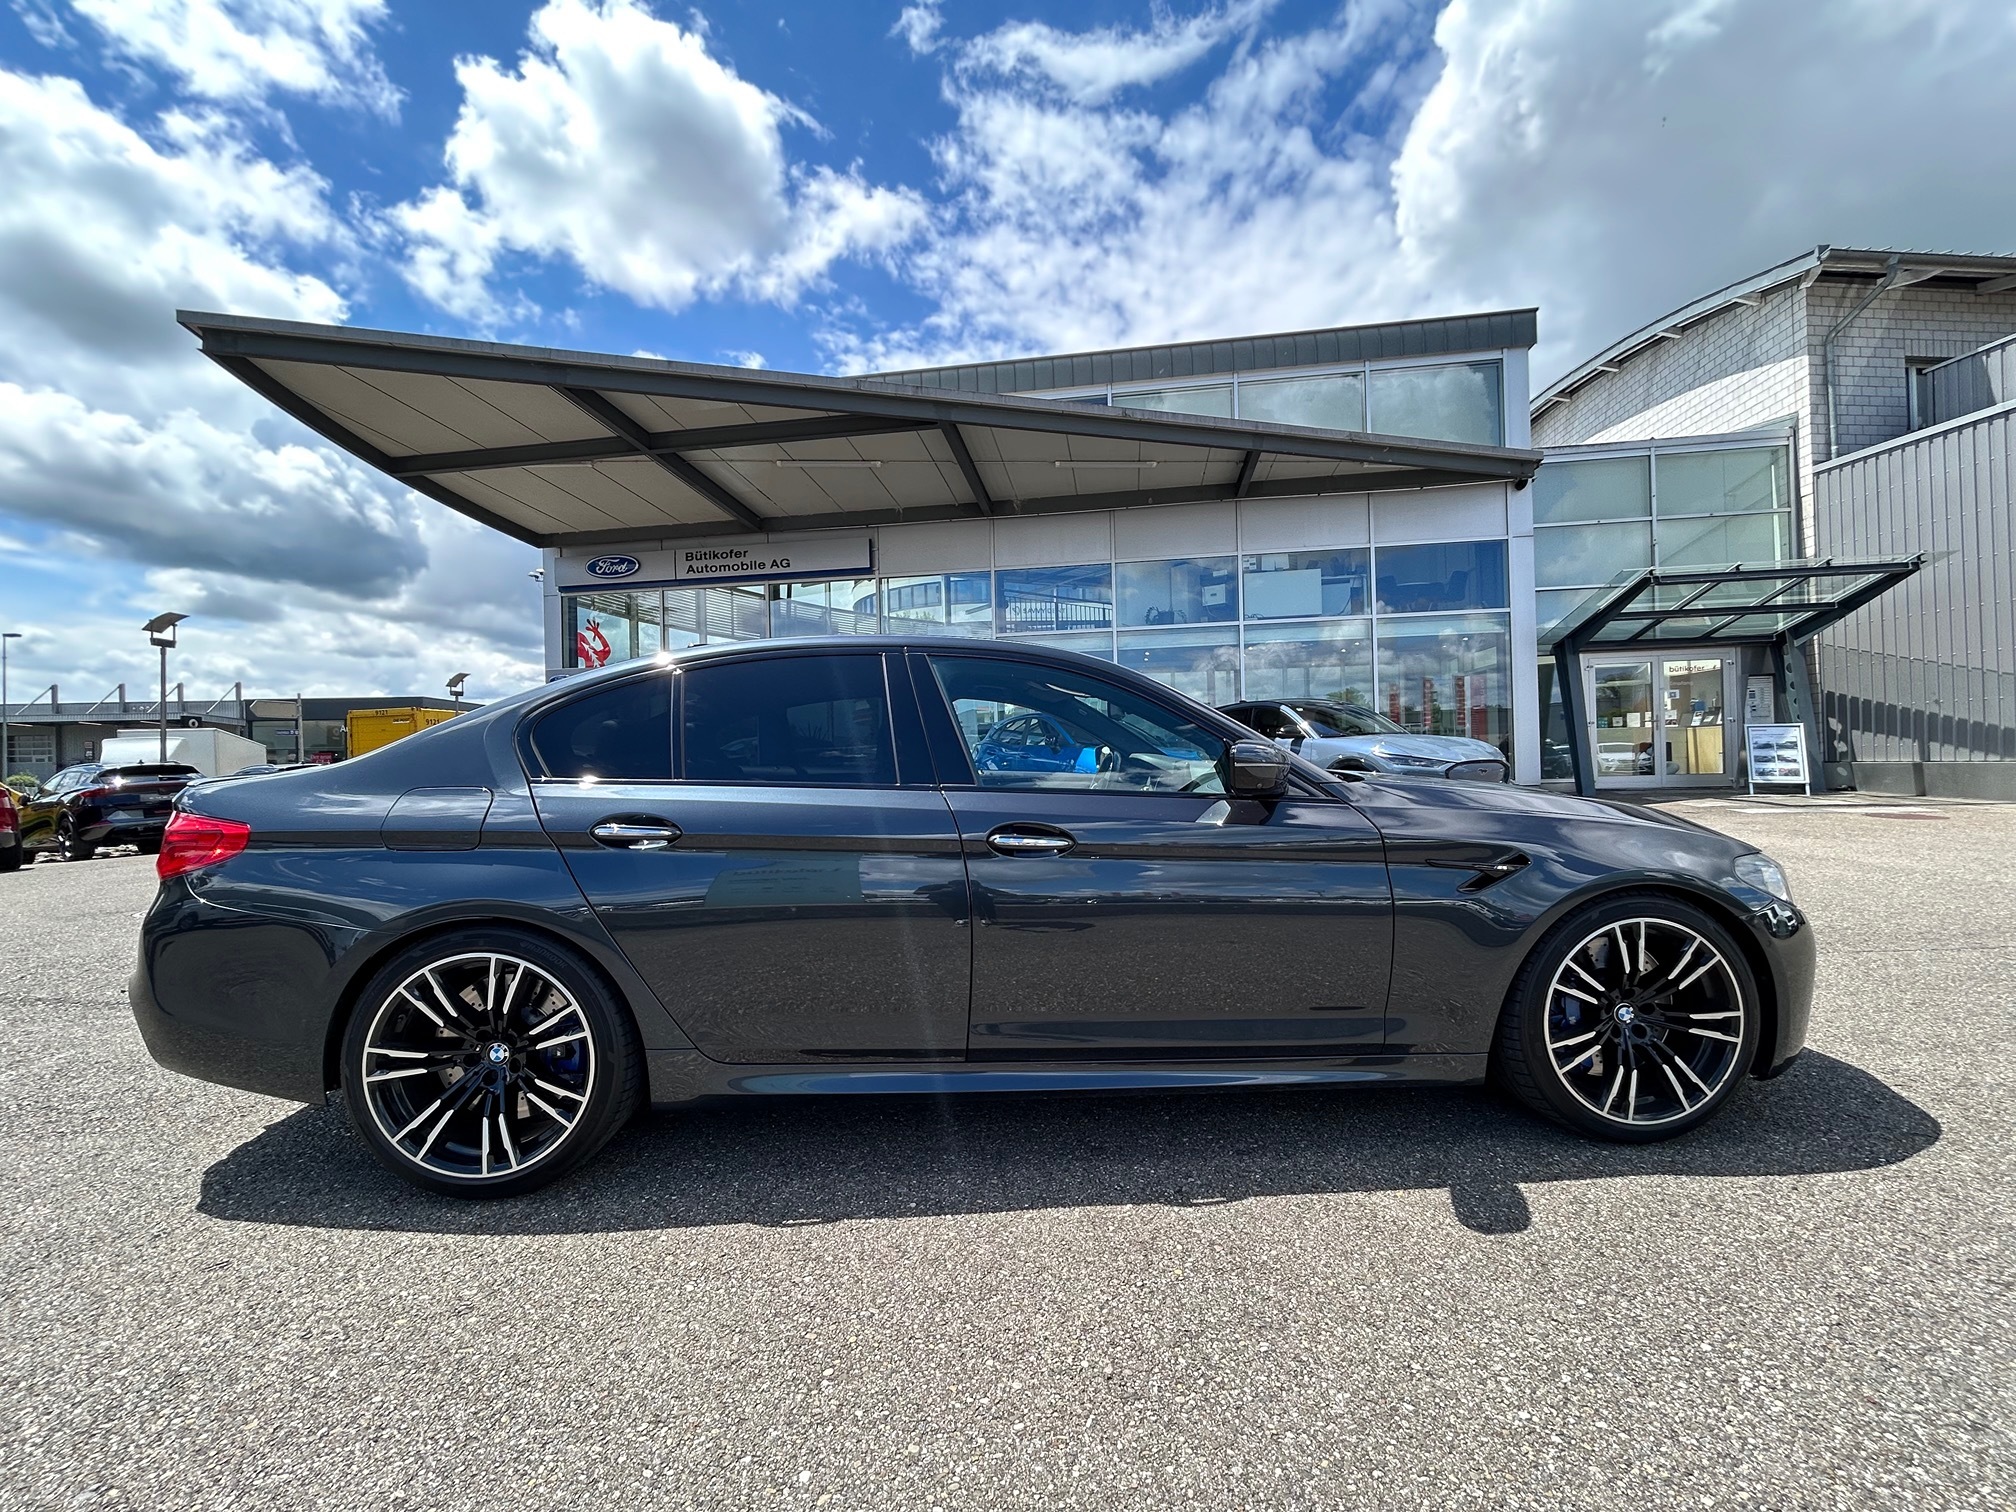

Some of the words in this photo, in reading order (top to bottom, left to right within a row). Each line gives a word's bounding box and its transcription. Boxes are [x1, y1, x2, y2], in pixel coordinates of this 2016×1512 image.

[685, 549, 749, 562] Bütikofer
[595, 558, 628, 574] Ford
[686, 560, 766, 574] Automobile
[770, 558, 791, 570] AG
[1669, 665, 1705, 673] bütikofer
